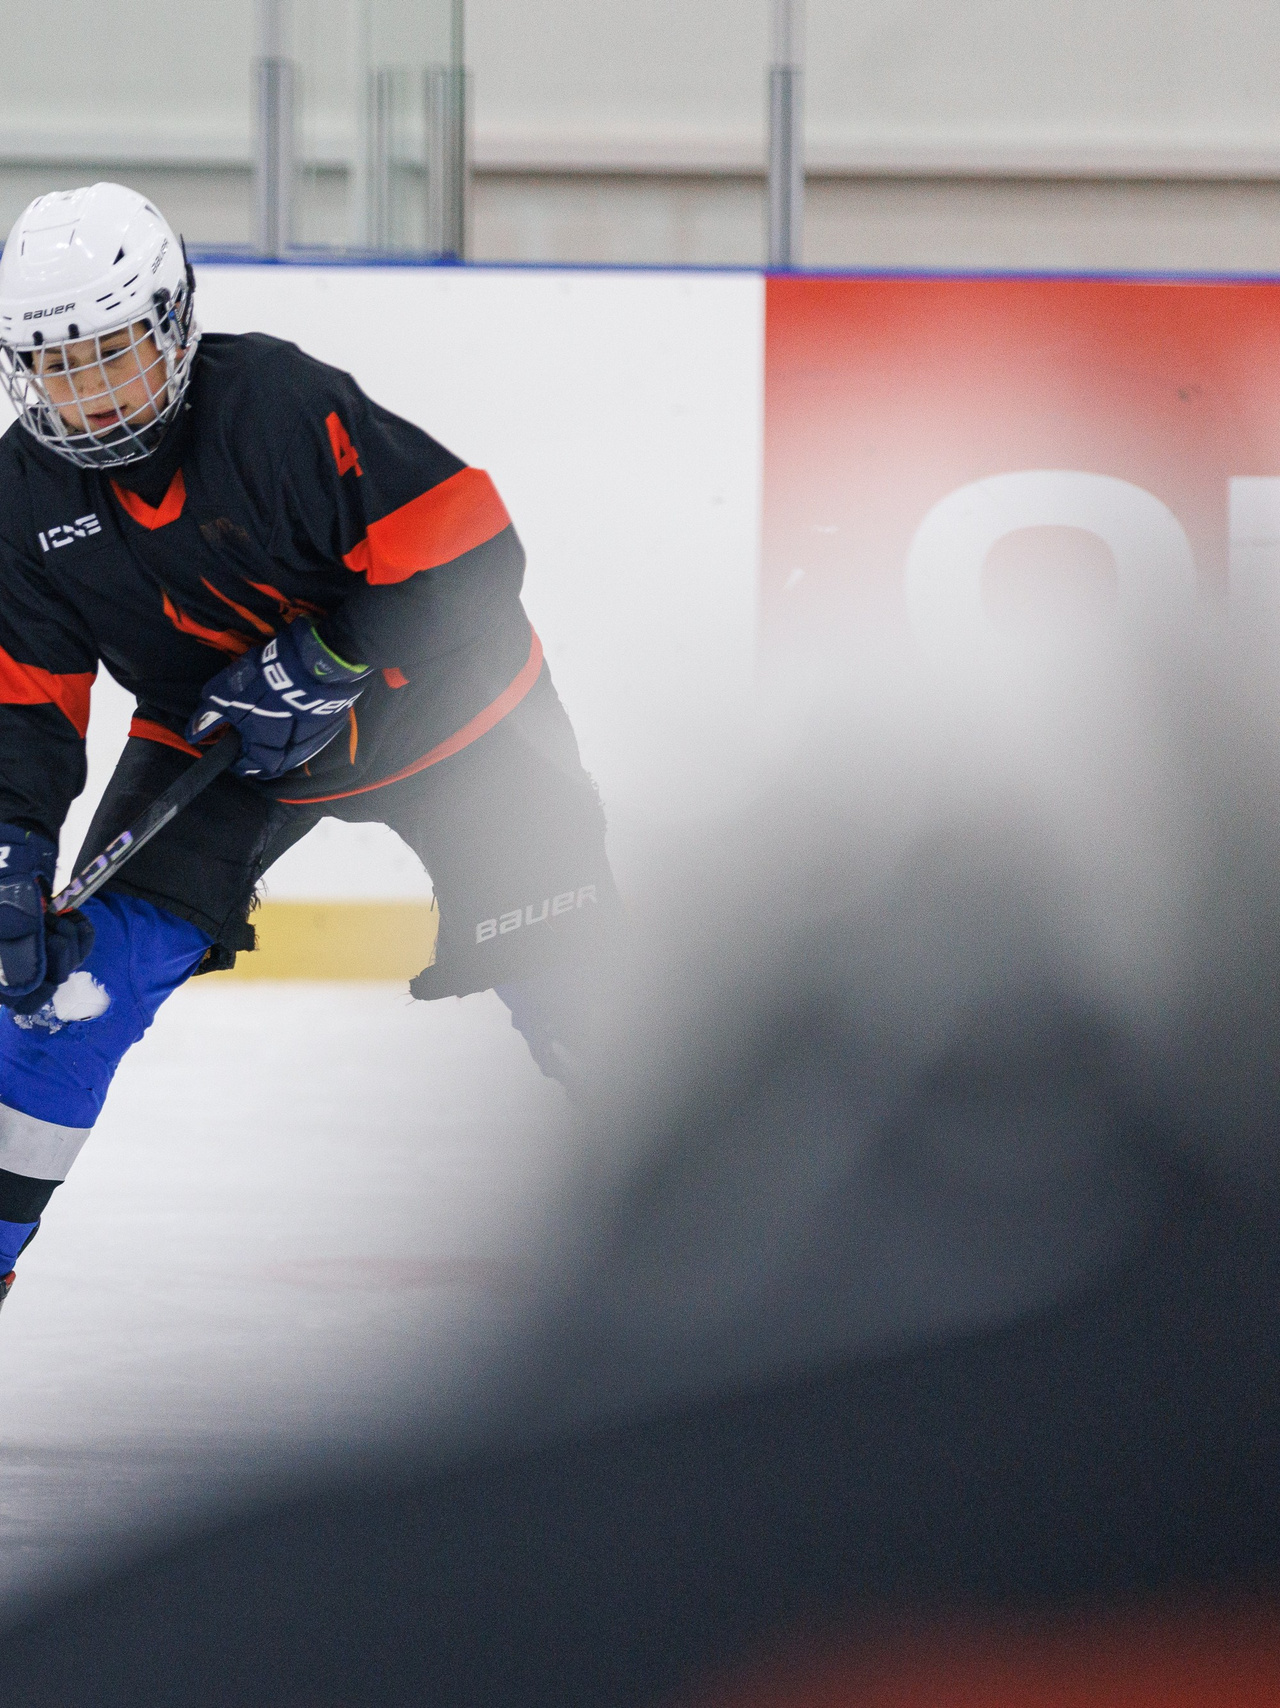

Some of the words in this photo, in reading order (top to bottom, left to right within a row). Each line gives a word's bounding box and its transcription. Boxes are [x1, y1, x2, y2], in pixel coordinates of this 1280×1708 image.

[23, 302, 76, 321] BAUER
[325, 411, 364, 477] 4
[476, 884, 597, 945] BAUER
